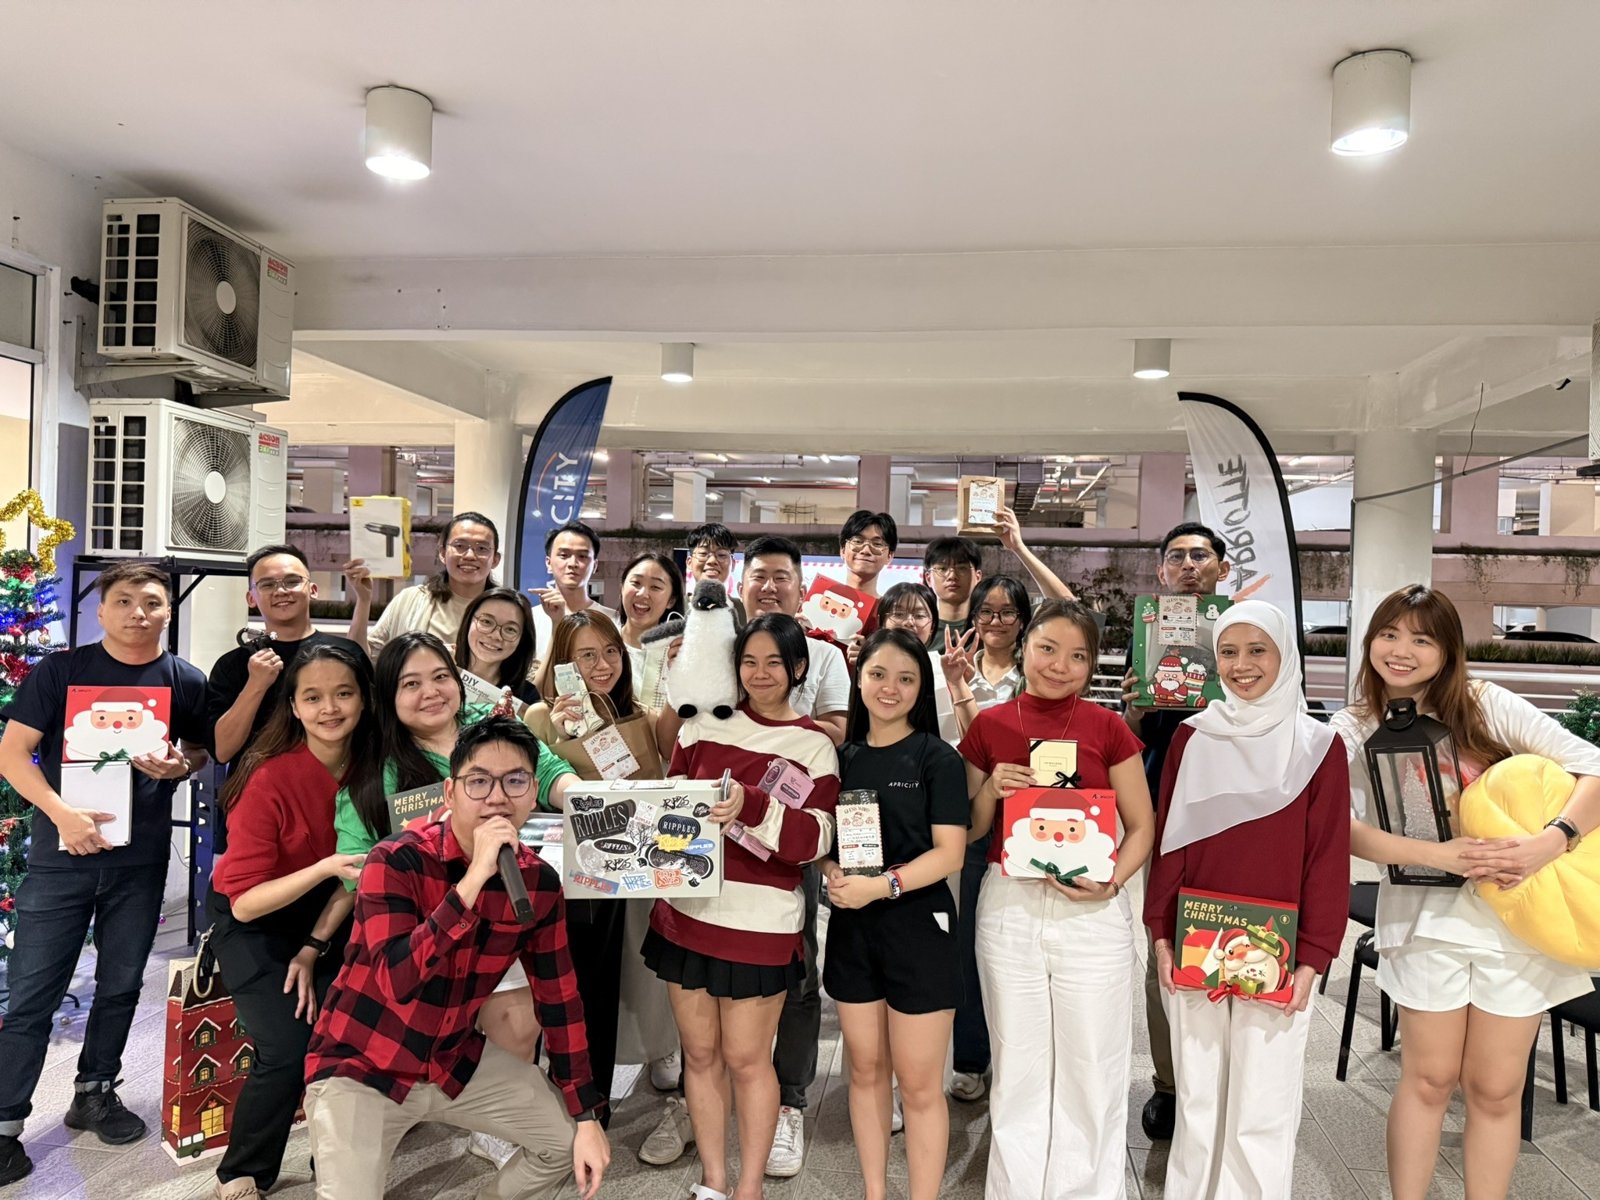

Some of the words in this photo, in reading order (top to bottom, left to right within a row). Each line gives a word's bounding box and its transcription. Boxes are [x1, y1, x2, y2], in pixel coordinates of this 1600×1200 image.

[462, 674, 480, 686] DIY
[394, 792, 428, 807] MERRY
[395, 795, 444, 815] CHRISTMA
[574, 804, 628, 838] RIPPLES
[662, 821, 696, 834] RIPPLES
[1184, 900, 1224, 914] MERRY
[1183, 910, 1248, 926] CHRISTMAS
